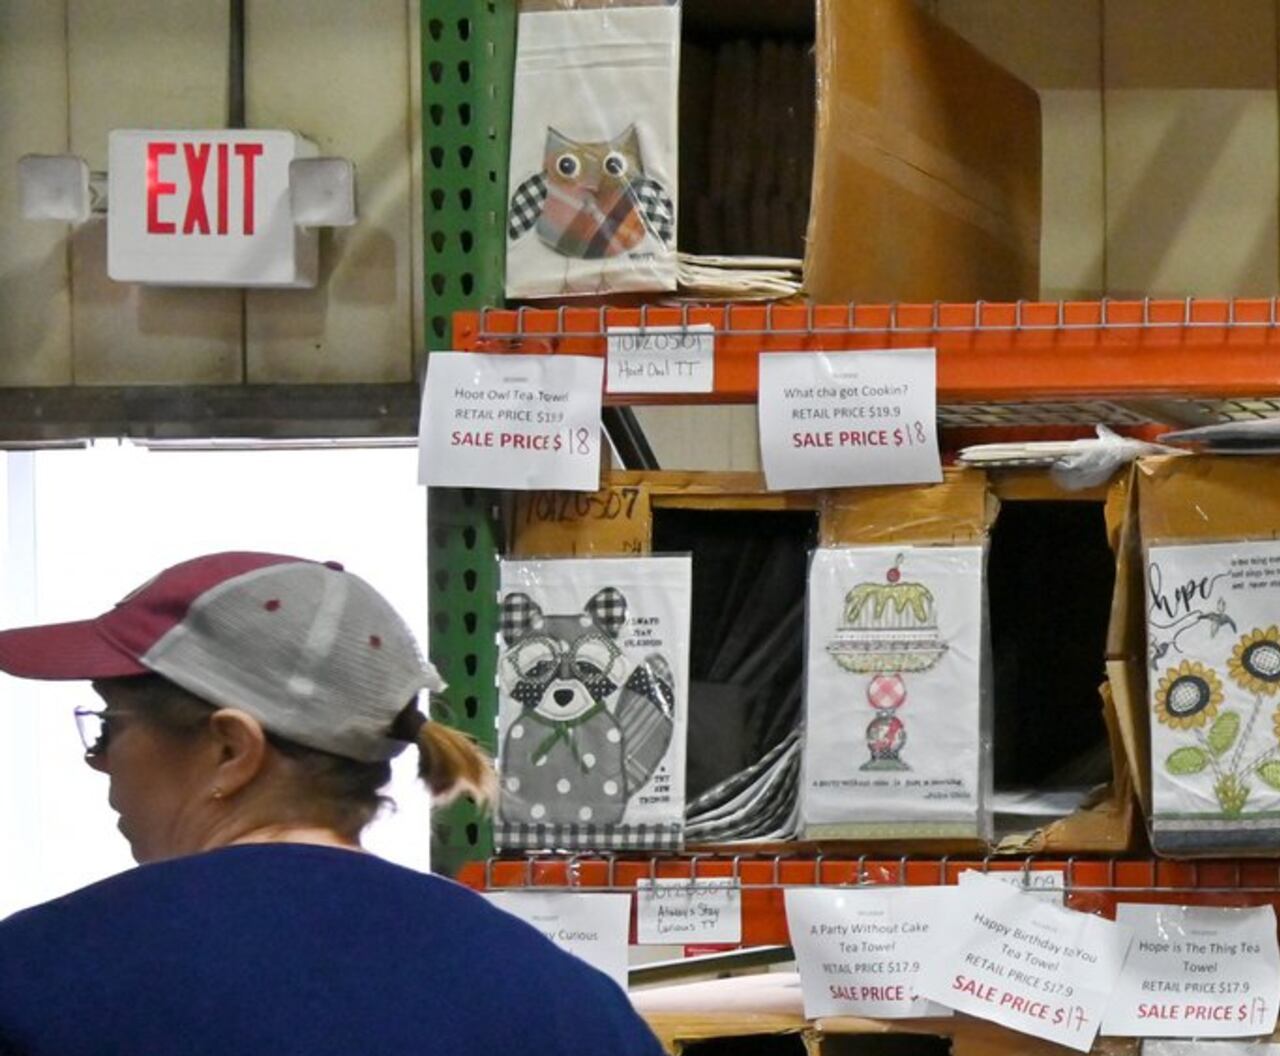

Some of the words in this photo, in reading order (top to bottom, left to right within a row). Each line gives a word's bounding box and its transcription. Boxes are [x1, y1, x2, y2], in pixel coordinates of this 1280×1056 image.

[146, 142, 263, 236] EXIT
[454, 388, 485, 401] Hoot
[487, 389, 510, 402] Owl
[513, 389, 534, 402] Tea
[784, 386, 814, 398] What
[817, 386, 836, 398] cha
[840, 386, 858, 399] got
[862, 384, 908, 397] Cookin?
[455, 408, 494, 420] RETAIL
[497, 410, 532, 422] PRICE
[792, 408, 829, 419] RETAIL
[834, 407, 865, 418] PRICE
[451, 431, 493, 448] SALE
[500, 432, 549, 450] PRICE
[793, 432, 834, 448] SALE
[840, 430, 888, 446] PRICE
[1148, 562, 1215, 618] hope
[558, 929, 598, 940] Curious
[810, 925, 818, 935] A
[821, 925, 848, 937] Party
[851, 924, 898, 934] Without
[901, 923, 929, 933] Cake
[974, 911, 1009, 935] Happy
[1013, 929, 1061, 955] Birthday
[840, 942, 858, 952] Tea
[860, 942, 895, 951] Towel
[1140, 941, 1169, 953] Hope
[1185, 942, 1207, 953] The
[1241, 944, 1260, 953] Tea
[1002, 943, 1021, 960] Tea
[1025, 951, 1060, 971] Towel
[854, 963, 883, 973] PRICE
[965, 953, 1005, 977] RETAIL
[1008, 968, 1044, 988] PRICE
[1183, 961, 1217, 972] Towel
[830, 985, 858, 1000] SALE
[861, 984, 904, 1000] PRICE
[1142, 981, 1181, 992] RETAIL
[1185, 982, 1217, 993] PRICE
[952, 975, 998, 1001] SALE
[1000, 992, 1050, 1020] PRICE
[1138, 1003, 1177, 1019] SALE
[1184, 1004, 1233, 1020] PRICE
